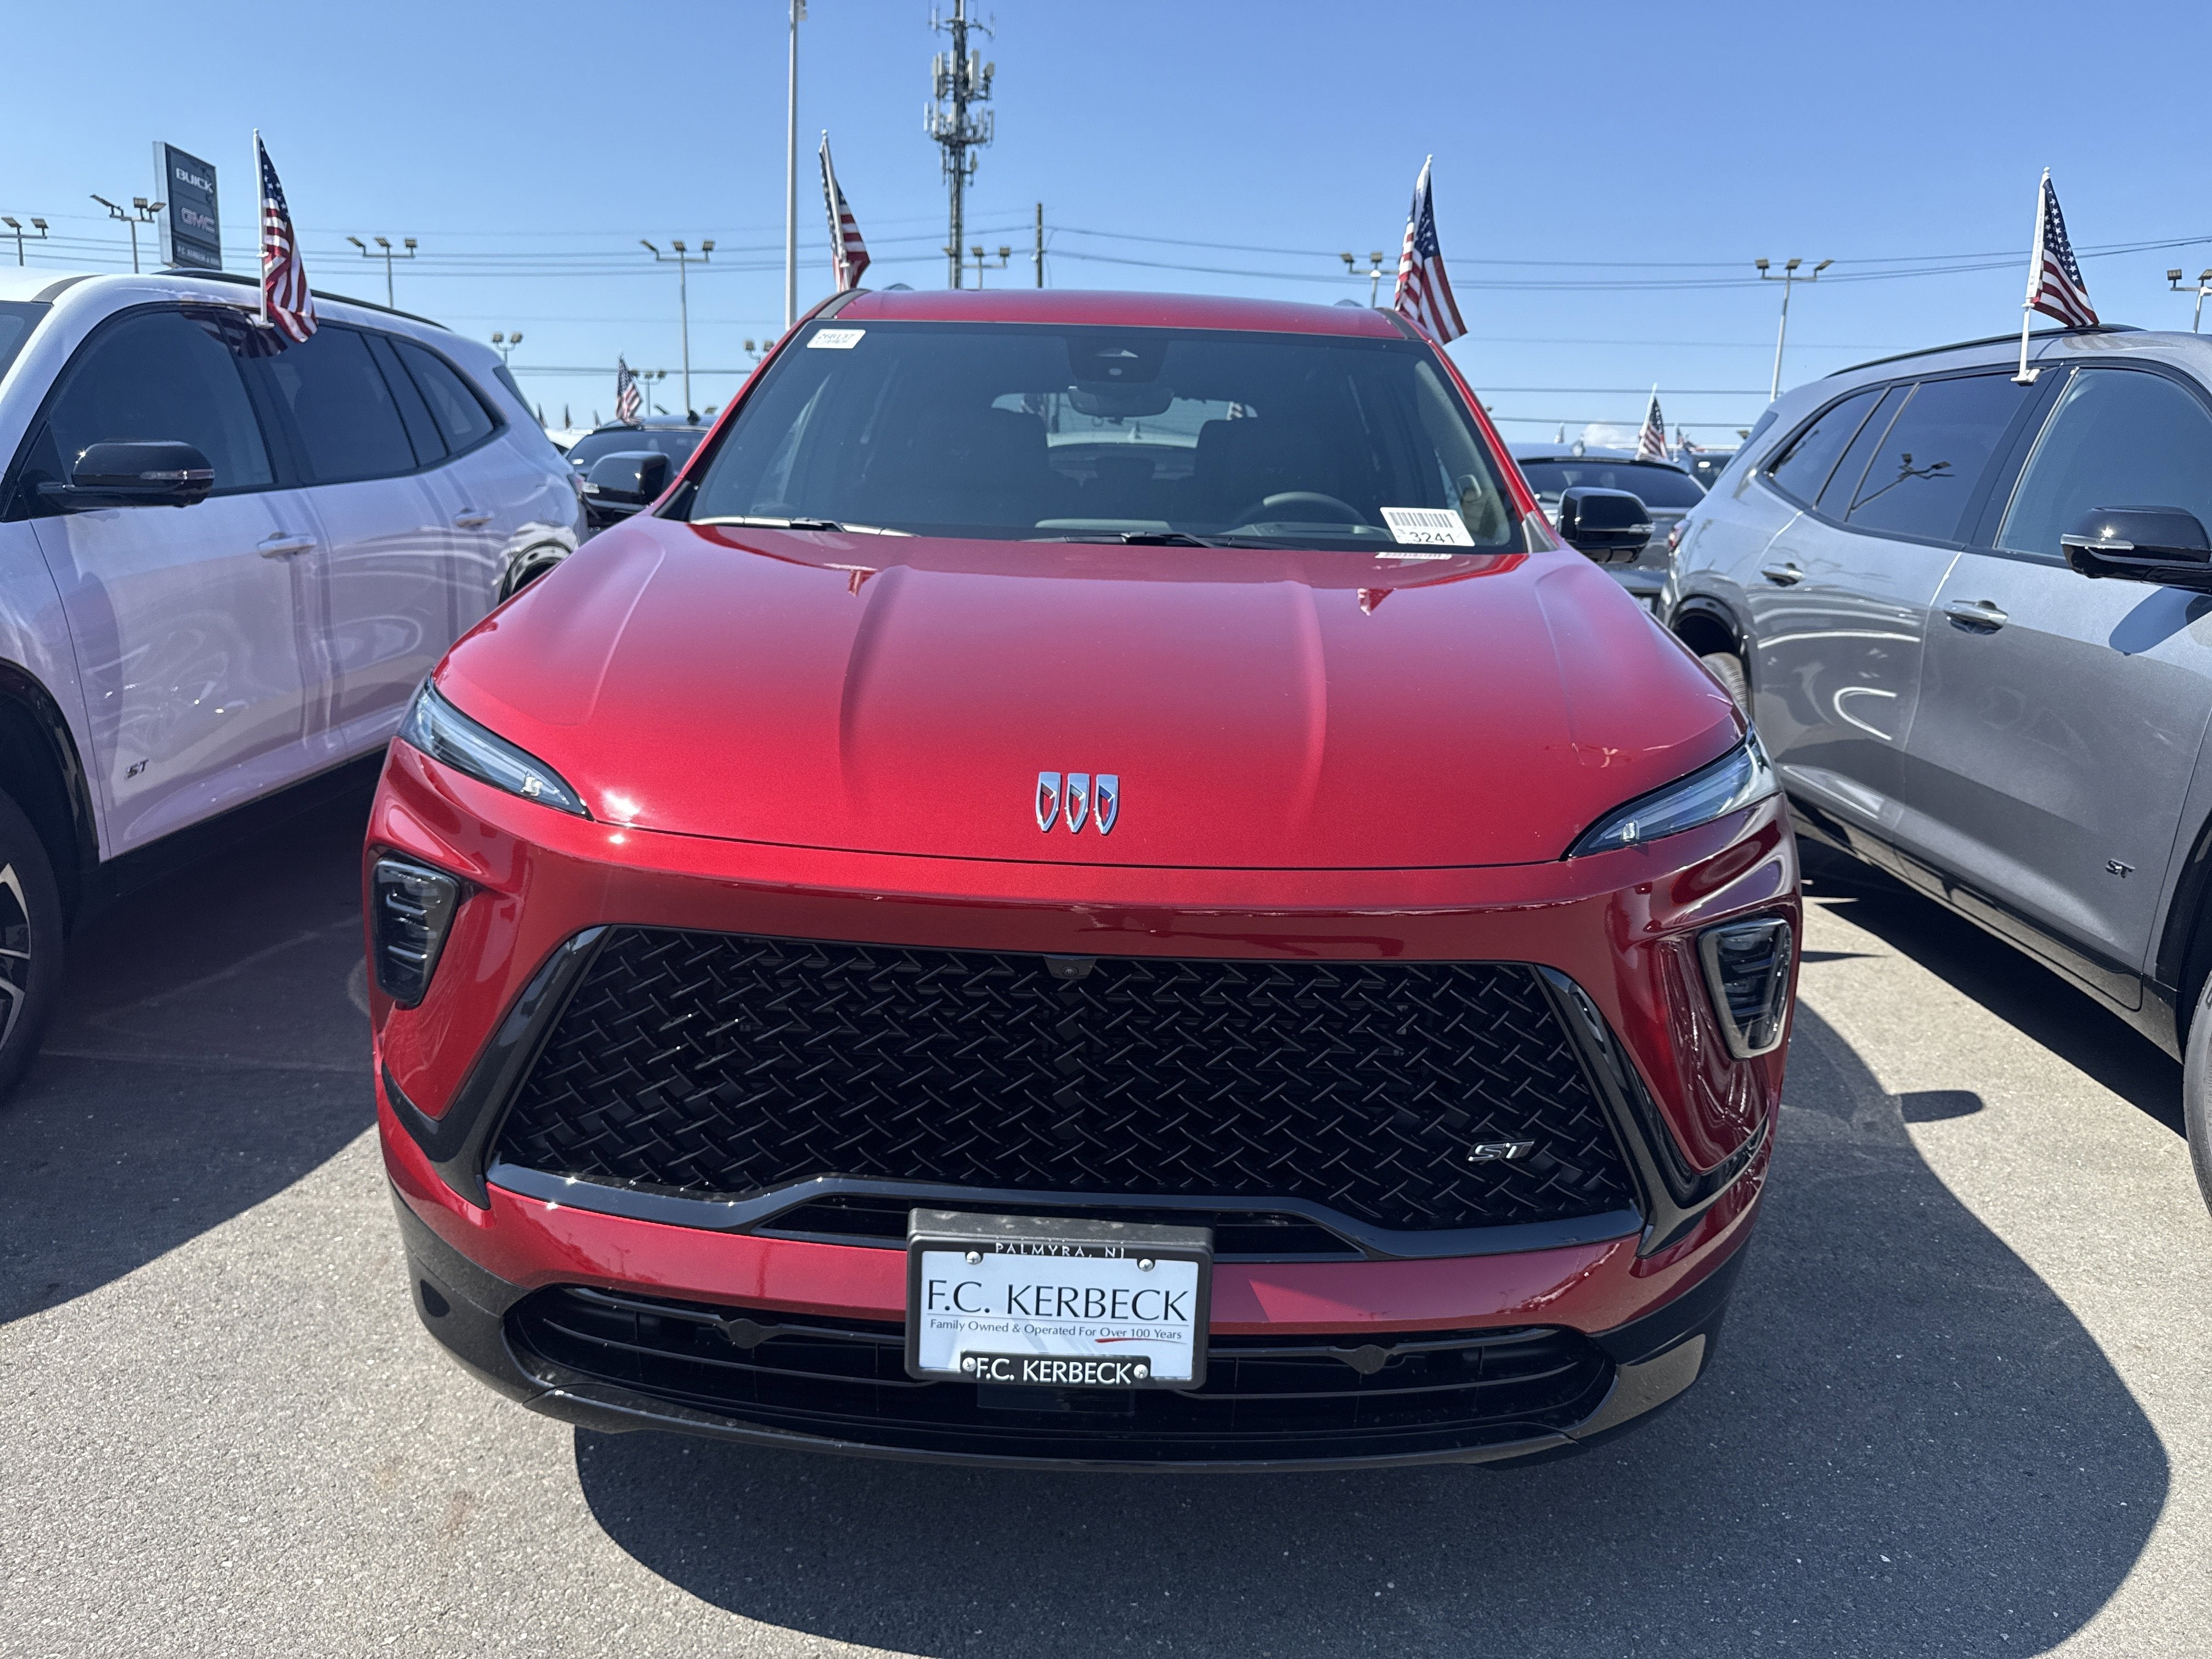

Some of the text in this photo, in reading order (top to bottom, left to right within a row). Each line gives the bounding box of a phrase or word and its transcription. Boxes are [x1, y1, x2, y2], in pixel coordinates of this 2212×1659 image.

[176, 167, 213, 194] BUICK
[182, 207, 215, 233] GMC
[1409, 532, 1455, 544] 3241
[127, 759, 149, 779] ST
[2106, 859, 2136, 878] ST
[1466, 1140, 1535, 1162] ST
[996, 1242, 1092, 1257] PALMYRA,
[928, 1279, 1189, 1322] F.C. KERBECK
[930, 1318, 1182, 1339] Family Owned & Operated For Over 100 Years
[976, 1357, 1132, 1386] F.C. KERBECK
